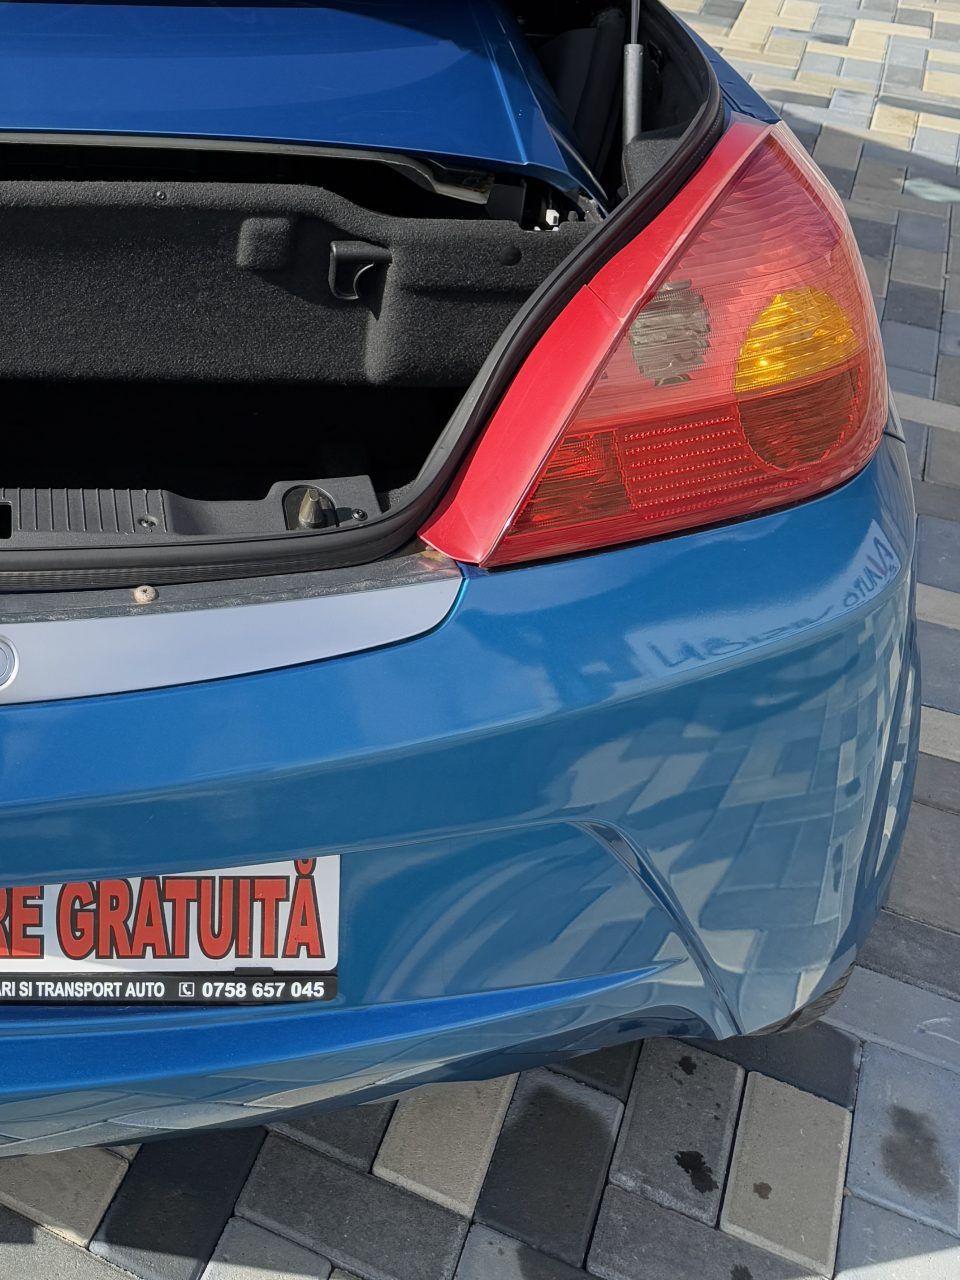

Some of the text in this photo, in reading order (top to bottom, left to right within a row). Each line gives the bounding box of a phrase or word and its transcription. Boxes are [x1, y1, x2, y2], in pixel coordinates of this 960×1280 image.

[56, 858, 326, 960] GRATUITĂ
[18, 981, 33, 997] SI
[36, 981, 122, 998] TRANSPORT
[125, 981, 165, 998] AUTO
[202, 981, 247, 998] 0758
[251, 981, 286, 998] 657
[290, 981, 325, 998] 045
